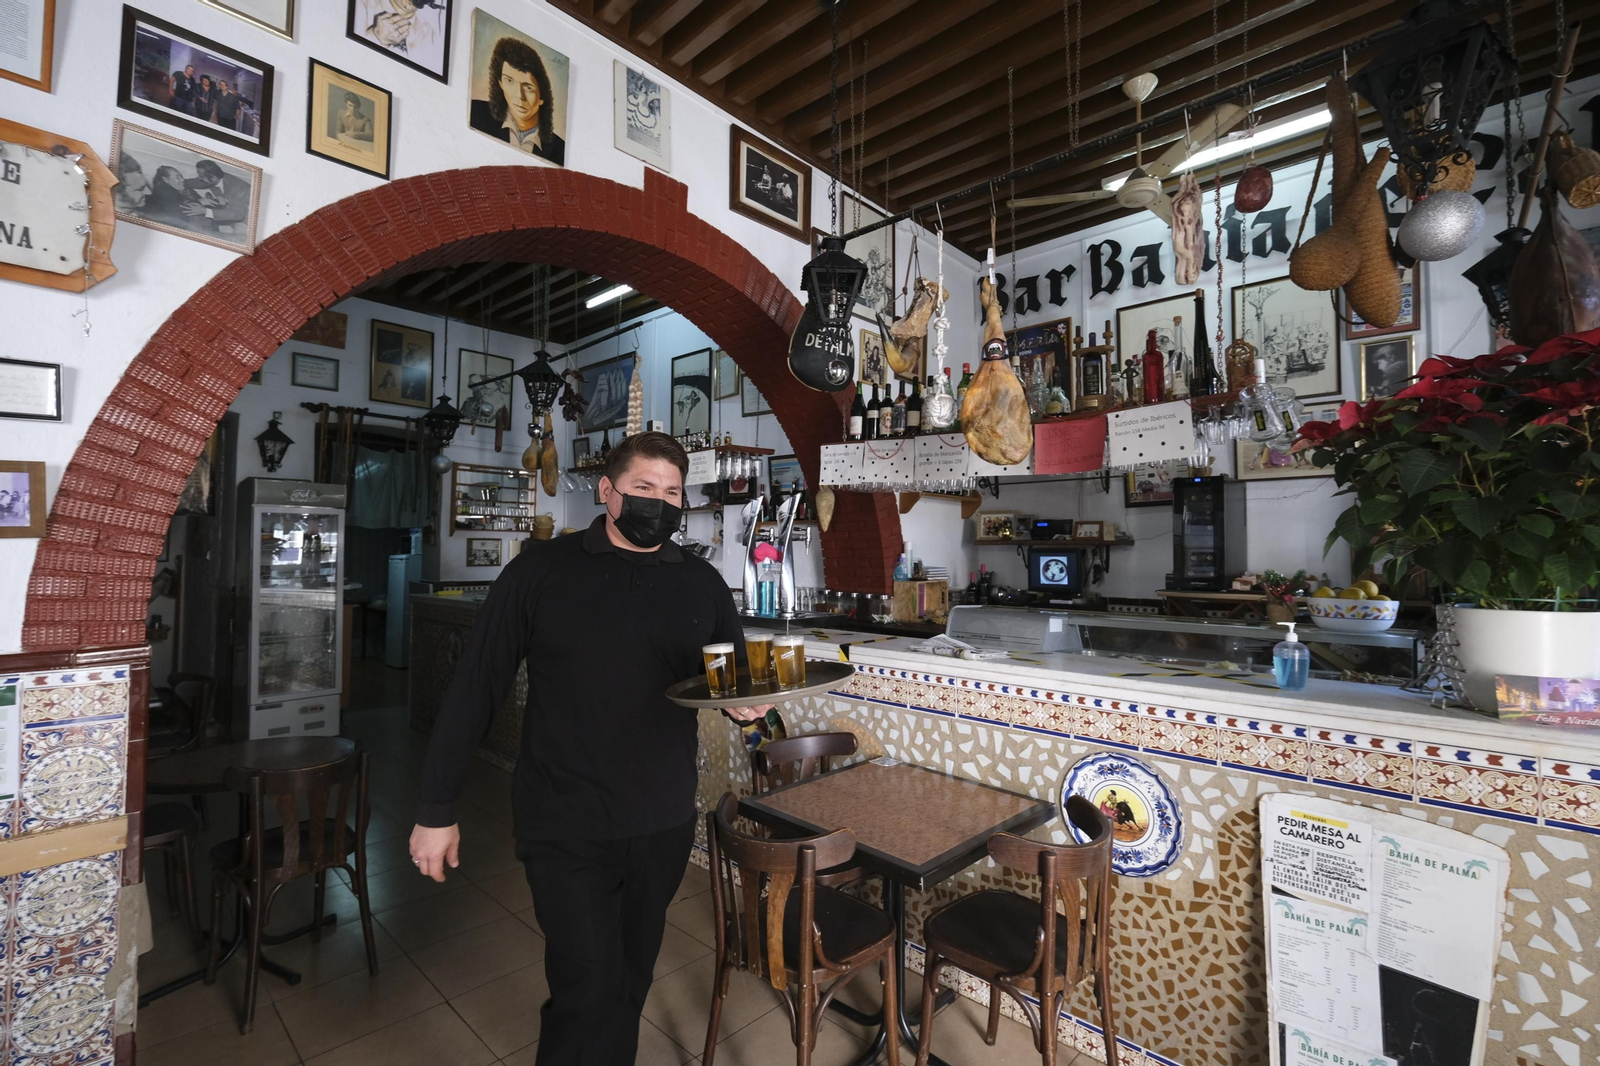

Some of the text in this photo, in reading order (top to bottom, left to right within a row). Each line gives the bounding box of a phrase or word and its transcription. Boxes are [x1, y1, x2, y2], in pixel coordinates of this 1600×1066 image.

[1086, 203, 1293, 300] Baia
[1114, 413, 1176, 428] Surtidos de Ibéricos
[1114, 429, 1131, 437] Ración
[1534, 713, 1562, 724] Feliz
[1277, 815, 1362, 843] PEDIR MESA AL
[1279, 826, 1345, 849] CAMARERO
[1316, 851, 1346, 863] RESPETE
[1316, 857, 1353, 870] DISTANCIA
[1389, 848, 1420, 864] BAHÍA
[1424, 858, 1437, 869] DE
[1441, 863, 1478, 880] PALMA
[1283, 867, 1303, 877] ENTRA
[1312, 876, 1332, 886] SALIR
[1335, 882, 1347, 890] DEL
[1272, 876, 1352, 905] DISPENSADORES DE GEL
[1332, 887, 1344, 895] USE
[1347, 892, 1360, 900] LOS
[1284, 911, 1311, 925] BAHÍA
[1315, 919, 1325, 928] DE
[1329, 922, 1360, 937] PALMA
[1301, 1042, 1329, 1060] BAHÍA
[1333, 1054, 1344, 1065] DE
